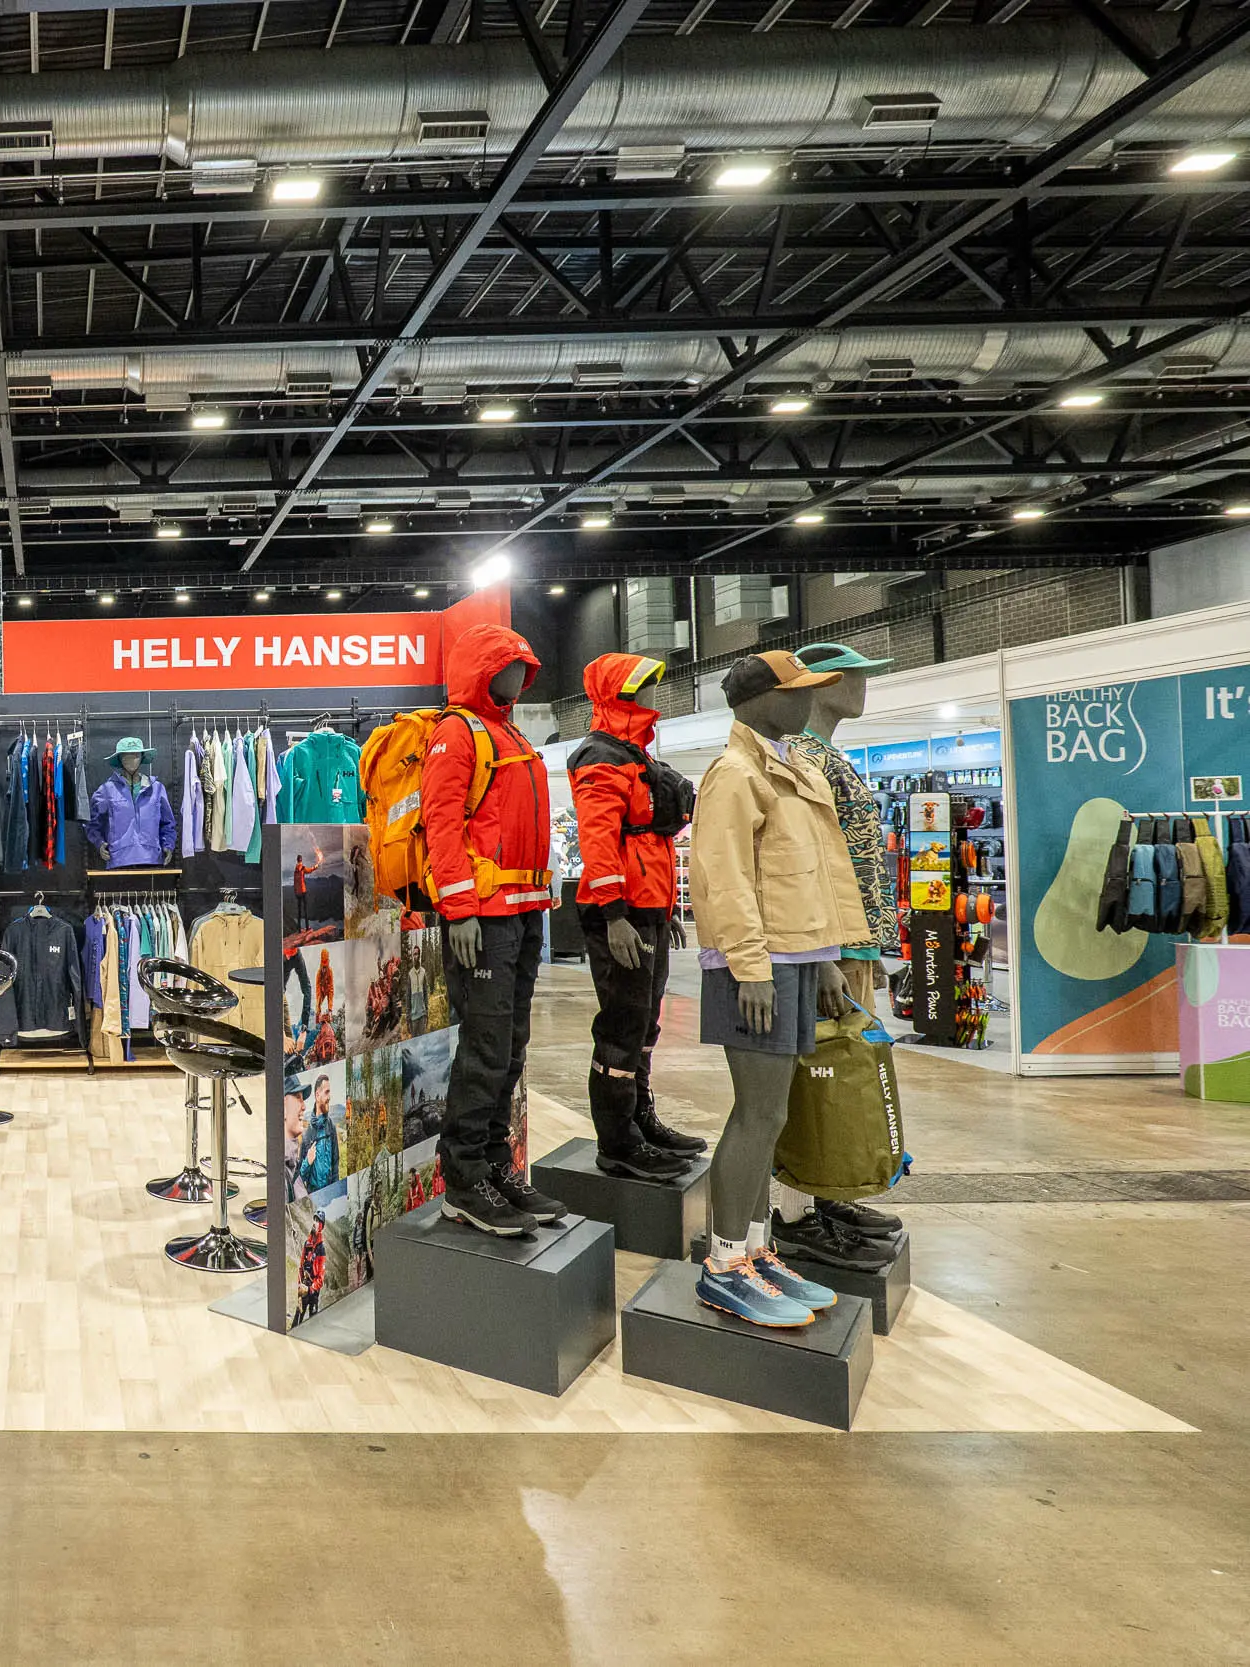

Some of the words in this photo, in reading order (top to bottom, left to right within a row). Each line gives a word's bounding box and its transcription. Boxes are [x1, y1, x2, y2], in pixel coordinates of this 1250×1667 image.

[113, 636, 241, 669] HELLY
[254, 634, 425, 667] HANSEN
[1046, 703, 1124, 727] BACK
[1205, 686, 1250, 720] It'
[430, 743, 447, 755] HH
[1046, 729, 1126, 762] BAG
[473, 968, 493, 980] HH
[927, 990, 940, 1020] Paws
[1218, 1005, 1250, 1014] BAC
[810, 1067, 835, 1078] HH
[877, 1063, 892, 1100] HELLY
[885, 1103, 900, 1155] HANSEN
